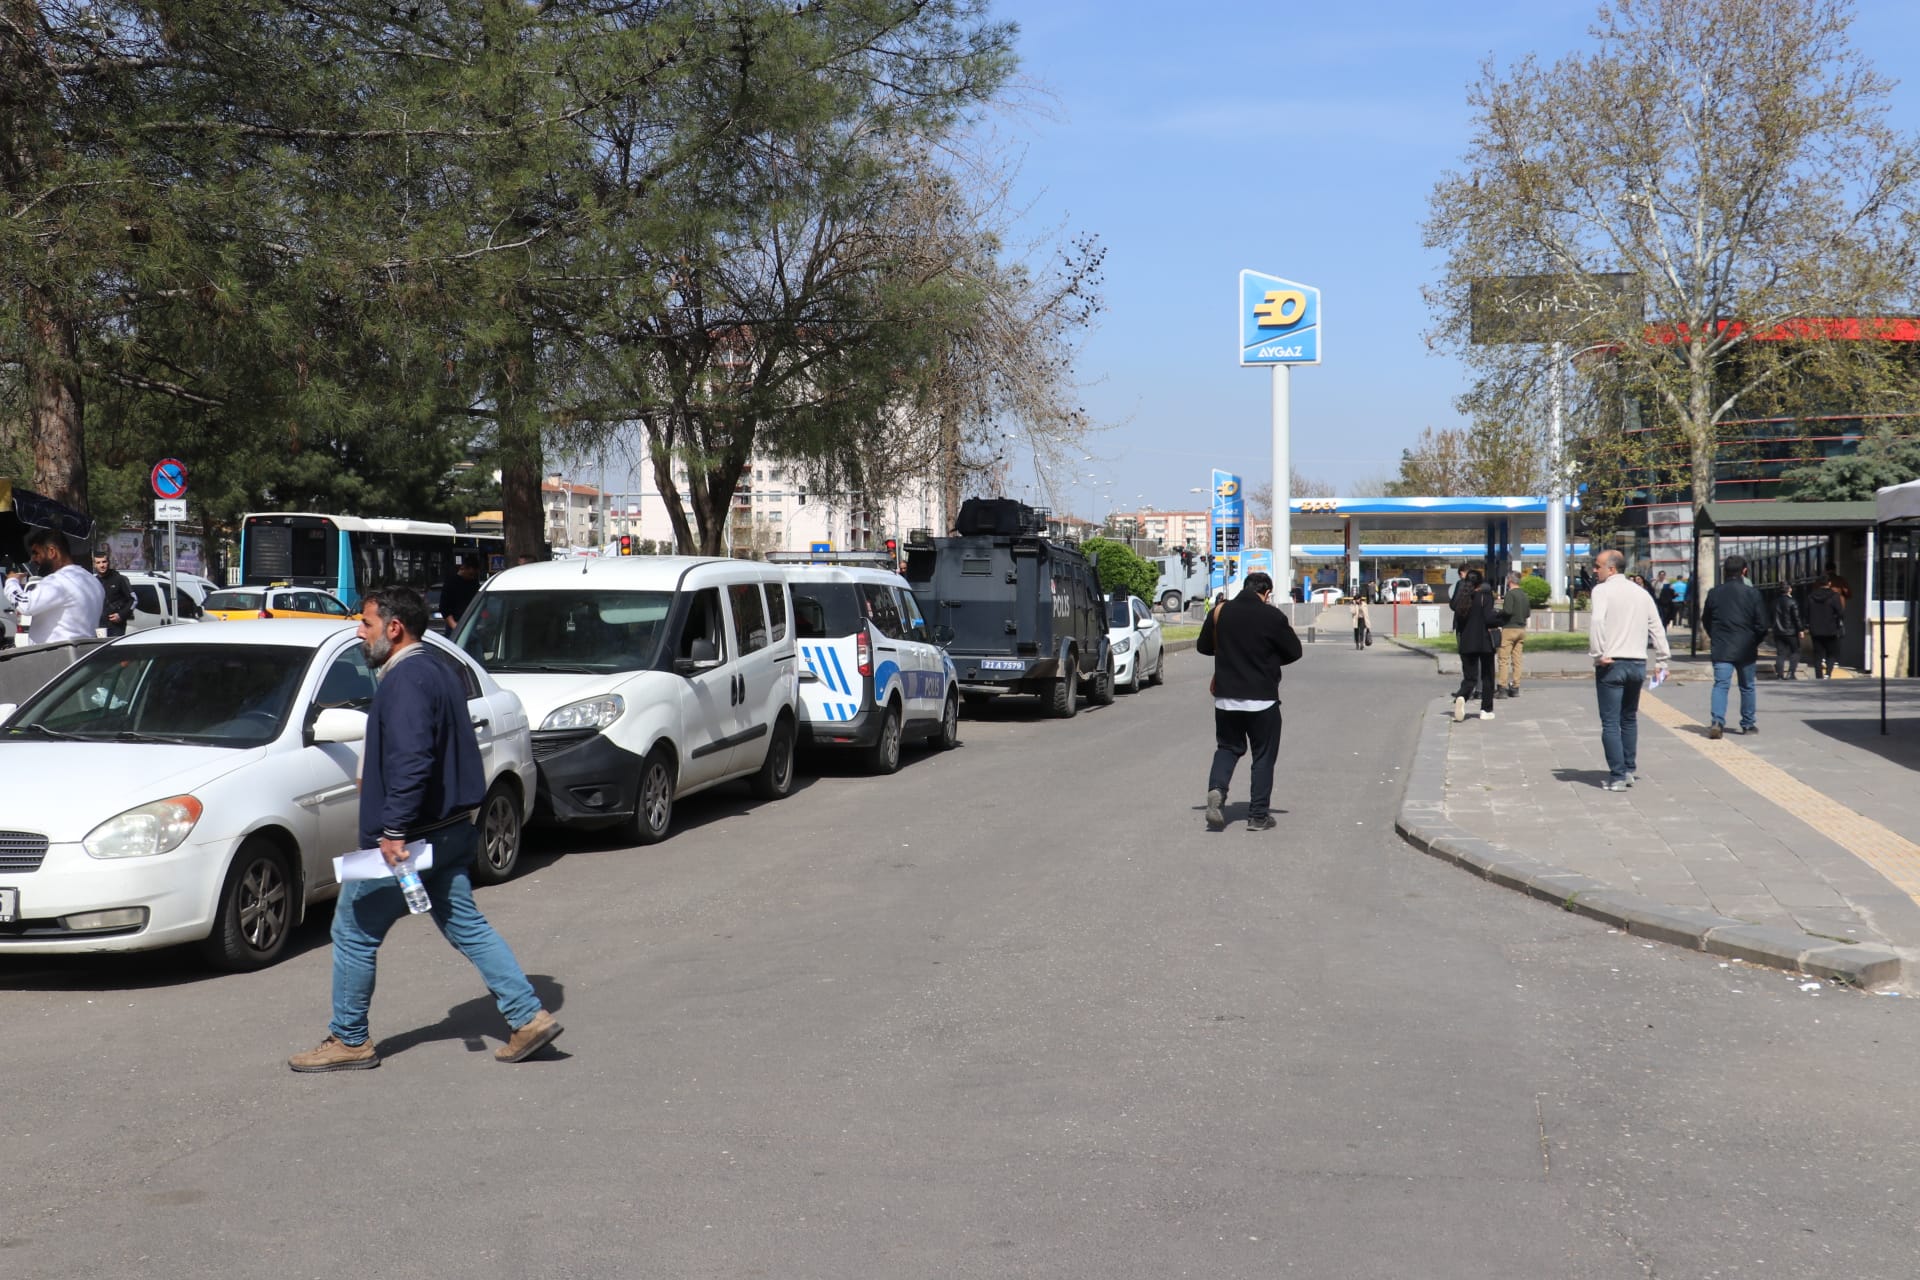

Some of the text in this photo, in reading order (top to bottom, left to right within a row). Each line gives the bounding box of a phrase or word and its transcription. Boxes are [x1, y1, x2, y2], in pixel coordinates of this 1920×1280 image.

[1258, 345, 1303, 358] AYGAZ
[1052, 589, 1070, 618] POLİS
[984, 661, 994, 669] 21
[995, 661, 1001, 669] A
